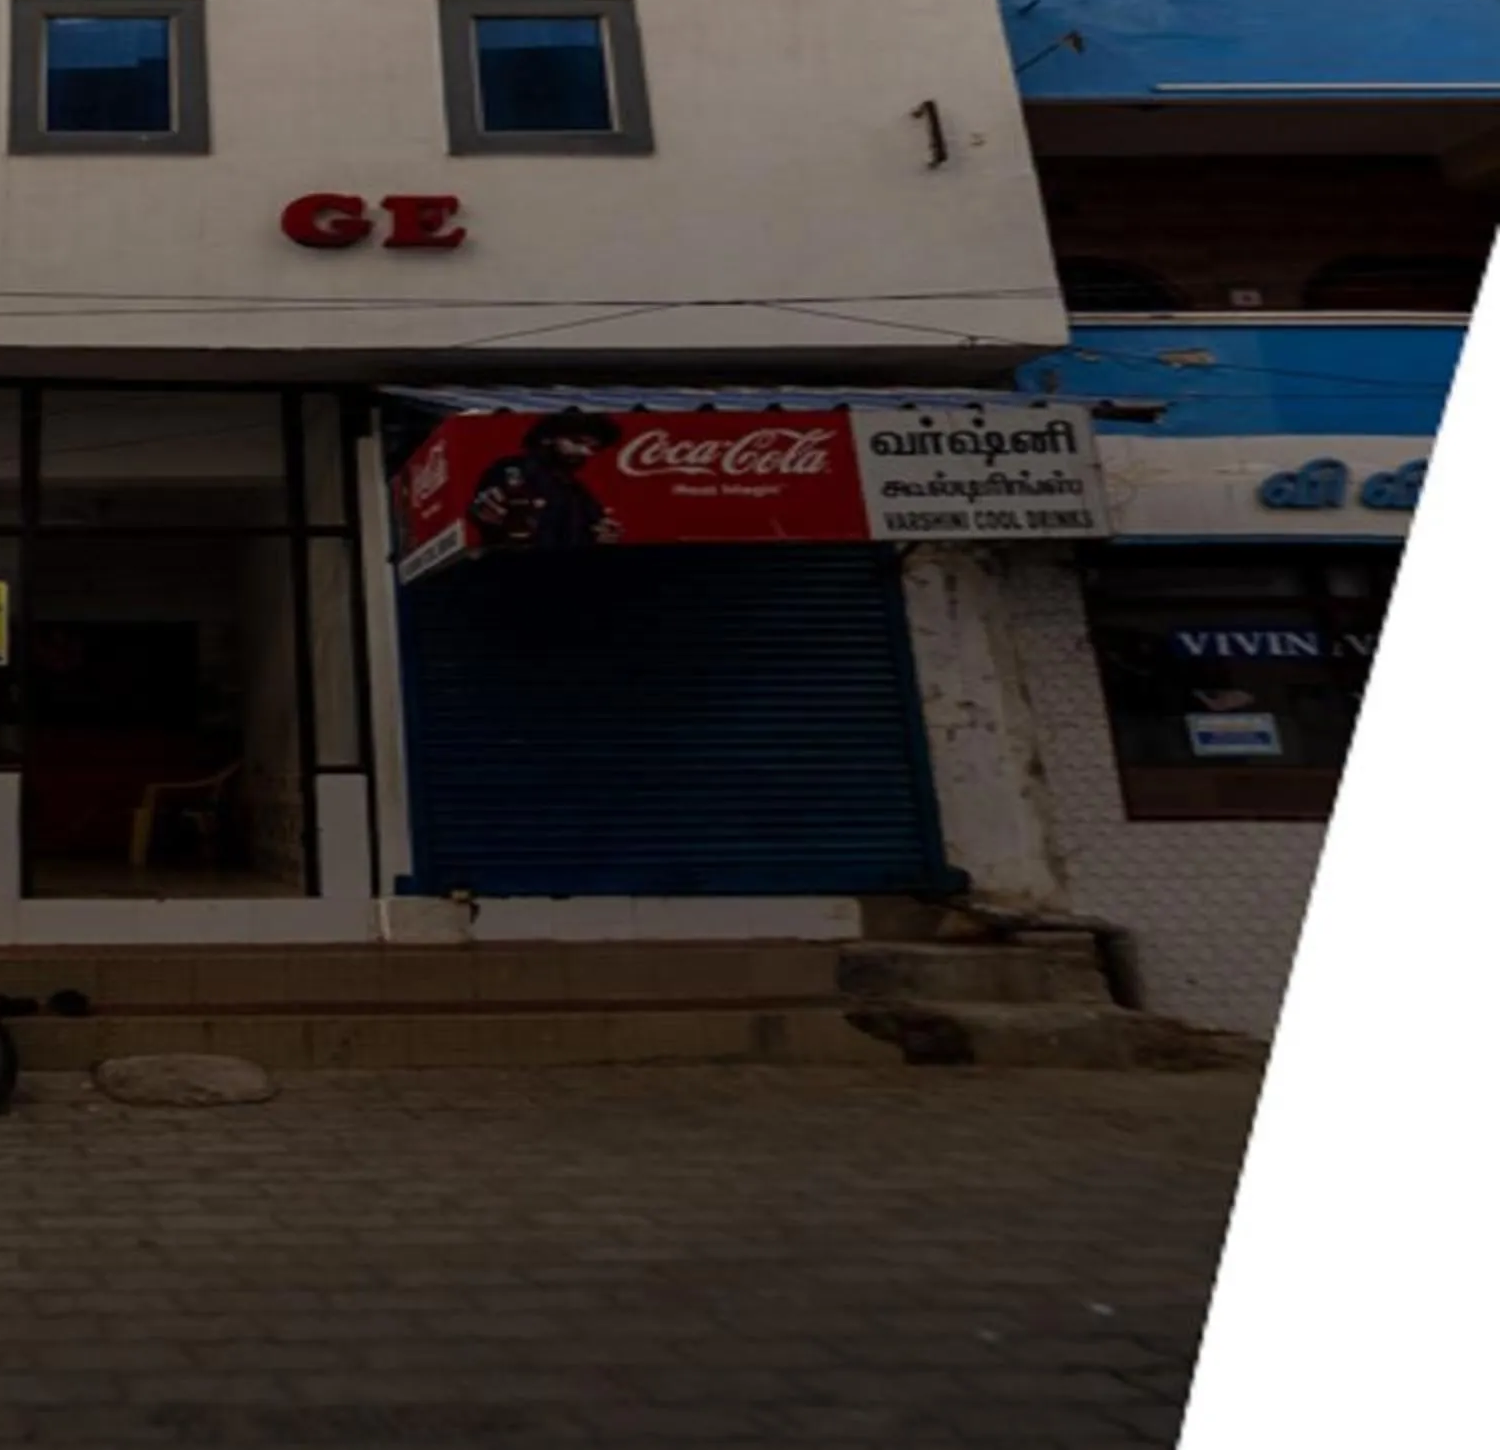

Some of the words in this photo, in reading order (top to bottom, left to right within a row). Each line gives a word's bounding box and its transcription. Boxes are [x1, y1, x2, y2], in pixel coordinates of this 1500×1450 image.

[281, 192, 467, 249] GE
[616, 427, 838, 478] Coca-Cola
[883, 510, 970, 531] VARSHINI
[973, 510, 1024, 530] COOL
[1025, 509, 1094, 529] DRINKS
[1176, 631, 1320, 657] VIVIN
